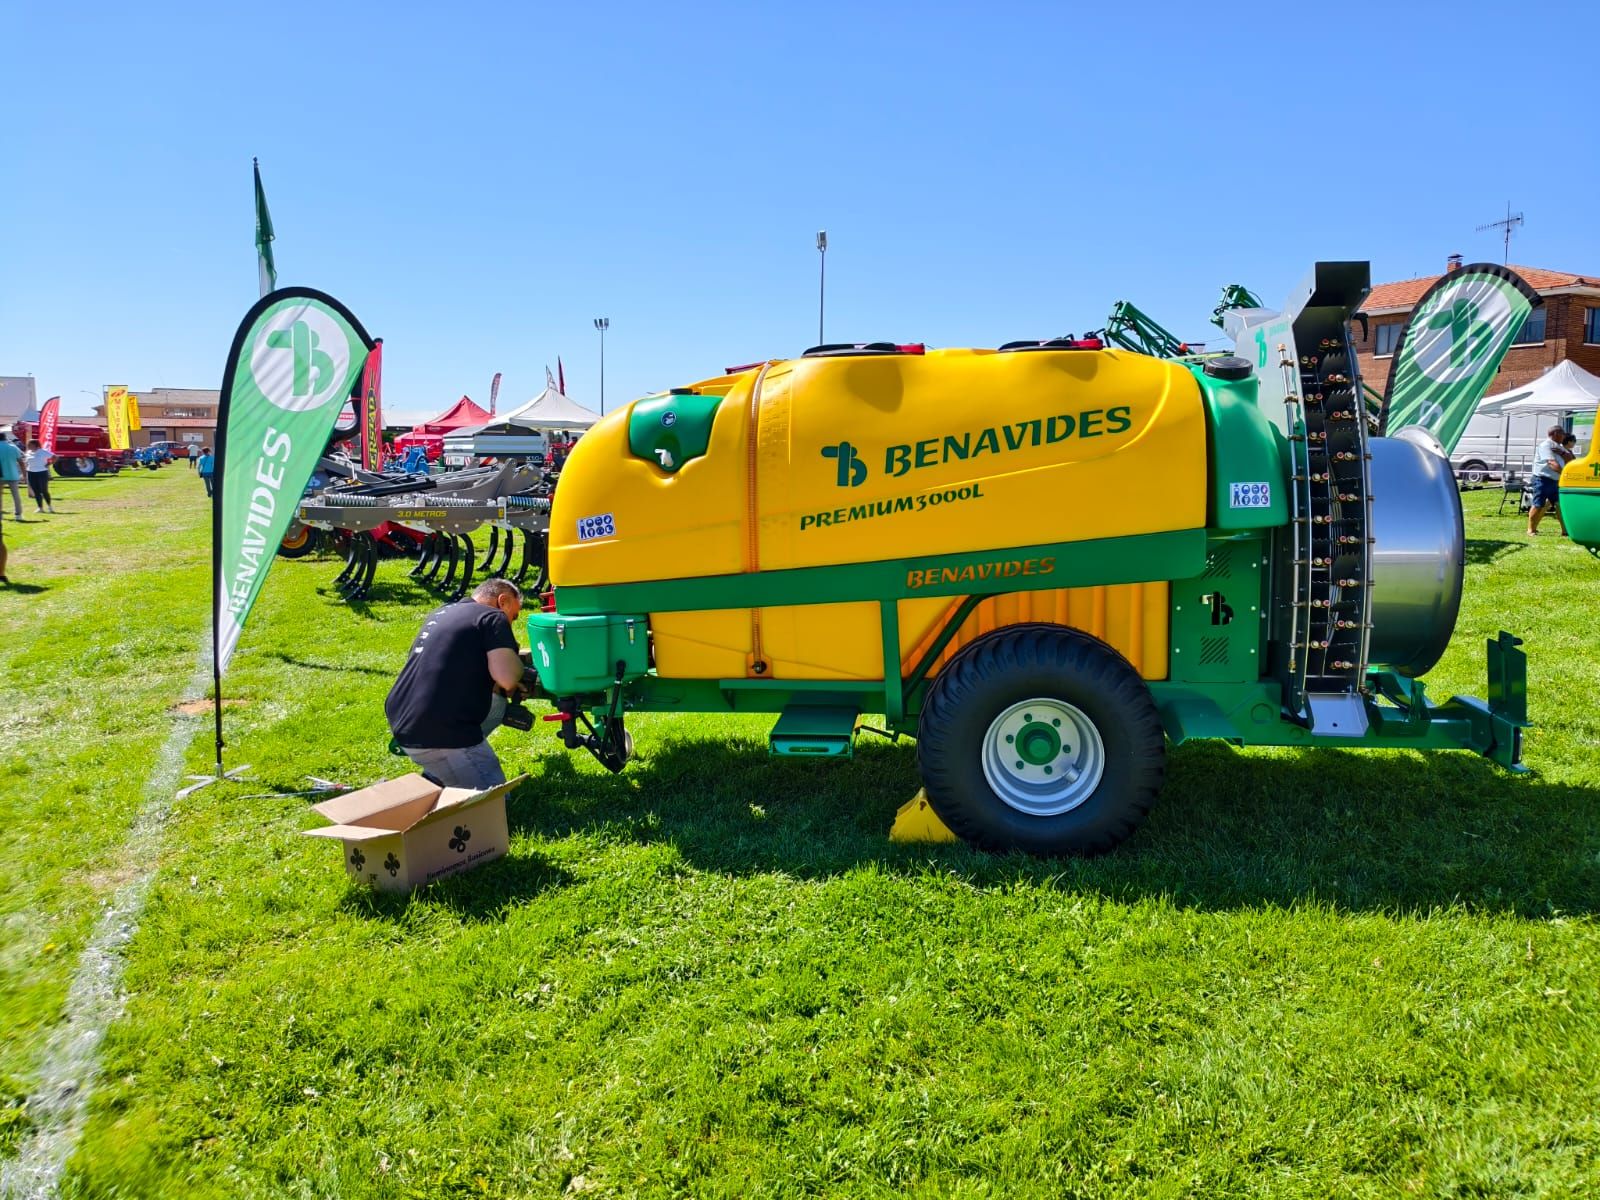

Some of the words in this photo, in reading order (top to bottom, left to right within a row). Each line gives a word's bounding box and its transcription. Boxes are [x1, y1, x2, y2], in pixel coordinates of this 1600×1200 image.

[884, 406, 1132, 477] BENAVIDES
[228, 427, 291, 613] BENAVIDES
[414, 511, 447, 519] METROS
[907, 557, 1056, 588] BENAVIDES
